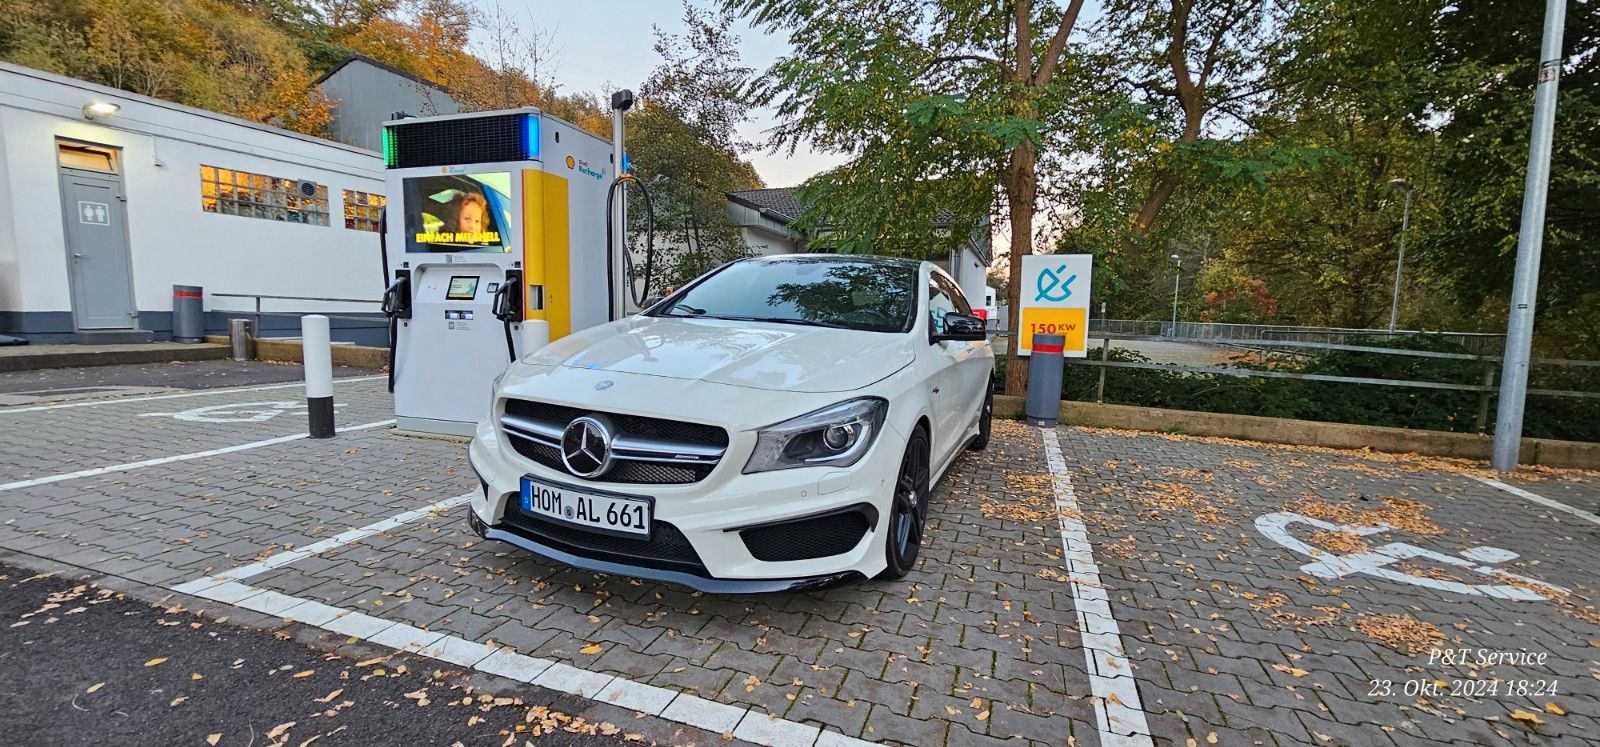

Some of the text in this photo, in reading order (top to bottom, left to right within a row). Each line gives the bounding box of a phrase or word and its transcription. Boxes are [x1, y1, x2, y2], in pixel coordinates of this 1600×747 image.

[579, 165, 603, 180] Recharge
[416, 232, 454, 243] EINFACH
[455, 232, 471, 242] MIT
[1031, 323, 1057, 334] 150
[531, 485, 646, 529] HOM AL 661
